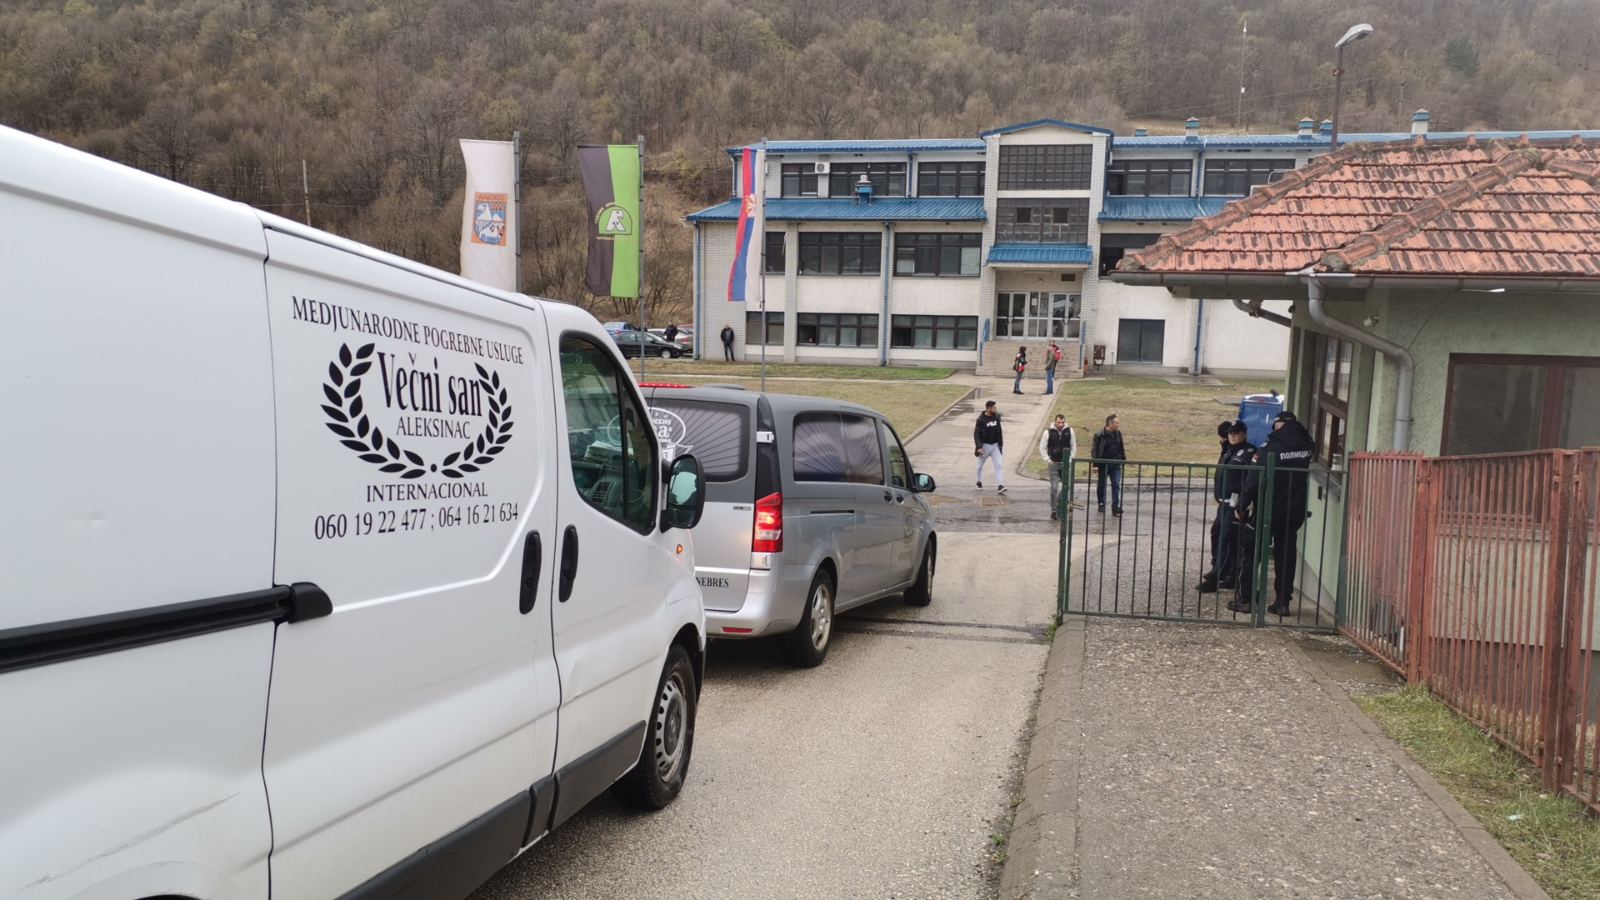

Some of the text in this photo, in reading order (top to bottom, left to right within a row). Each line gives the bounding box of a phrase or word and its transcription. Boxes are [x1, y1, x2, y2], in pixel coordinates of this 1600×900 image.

[291, 296, 524, 365] MEDJUNARODNE POGREBNE USLUGE
[377, 351, 482, 417] Večni san
[396, 416, 471, 440] ALEKSINAC
[1280, 450, 1311, 460] ПОЛИЦИ
[366, 482, 488, 503] INTERNACIONAL
[314, 513, 347, 540] 060
[355, 511, 373, 536] 19
[378, 510, 396, 534] 22
[401, 508, 426, 532] 477
[438, 506, 461, 528] 064
[466, 504, 480, 525] 16
[483, 503, 496, 523] 21
[499, 502, 518, 522] 634
